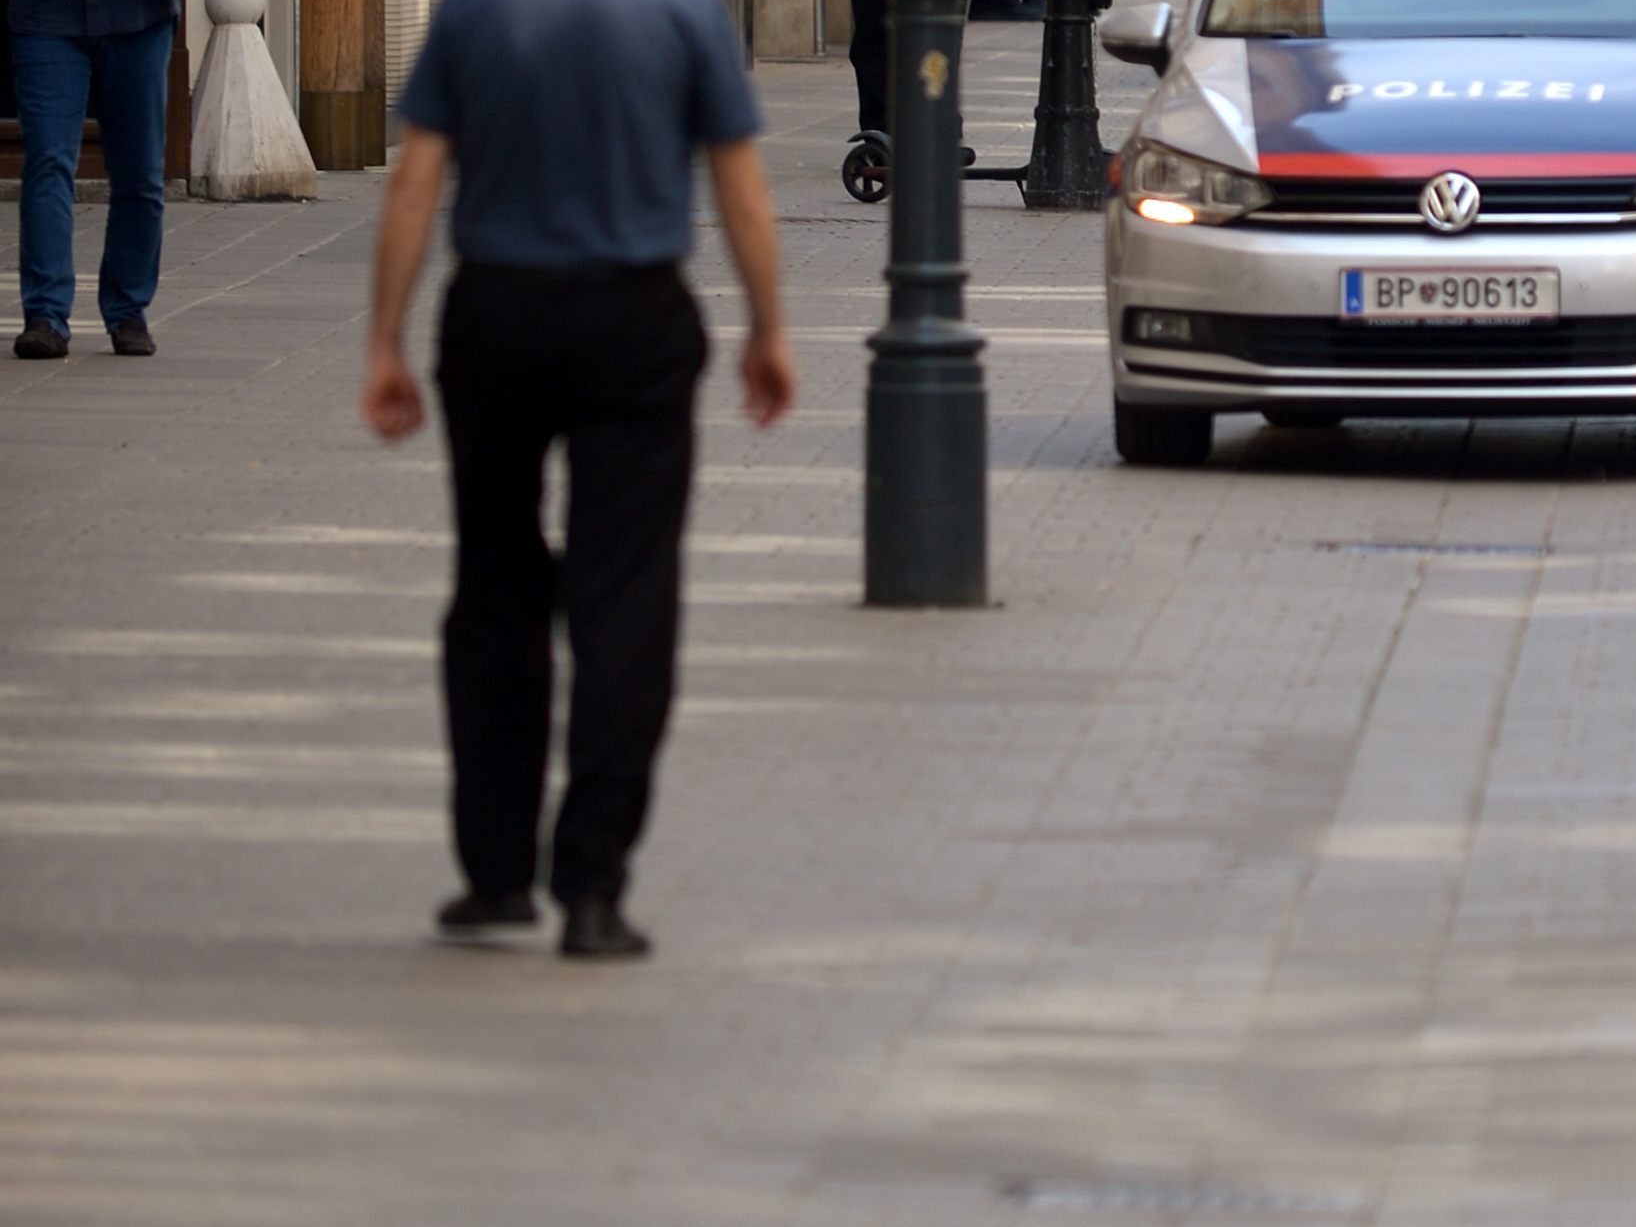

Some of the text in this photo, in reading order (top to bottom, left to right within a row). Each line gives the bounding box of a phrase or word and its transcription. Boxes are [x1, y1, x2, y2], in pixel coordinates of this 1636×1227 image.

[1326, 79, 1606, 103] POLIZEI
[1376, 277, 1415, 309] BP
[1442, 277, 1538, 309] 90613
